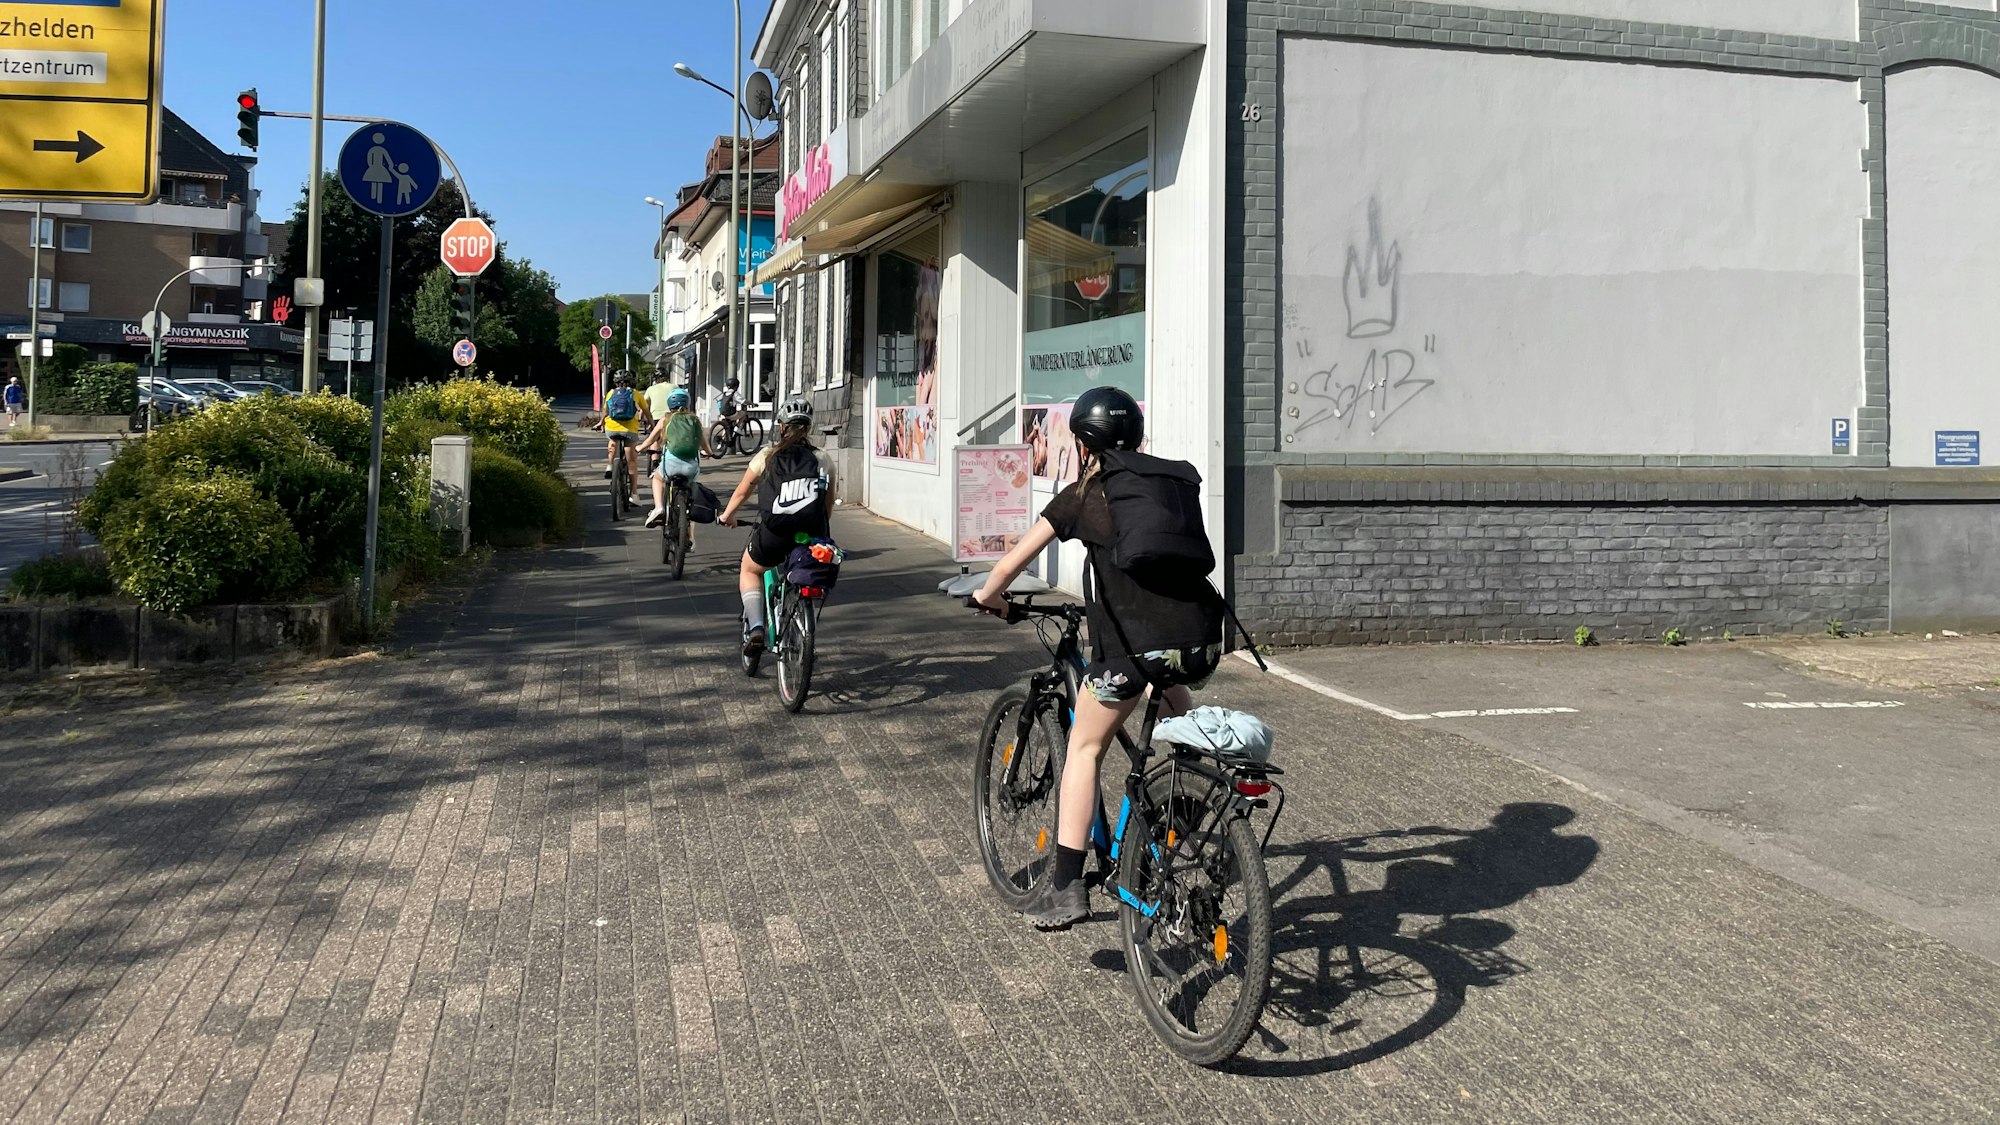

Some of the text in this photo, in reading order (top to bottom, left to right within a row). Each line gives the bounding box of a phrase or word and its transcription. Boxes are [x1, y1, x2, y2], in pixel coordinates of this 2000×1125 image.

[1241, 102, 1261, 121] 26
[446, 236, 489, 258] STOP
[122, 323, 250, 339] KRNGYMNASTIK
[1835, 420, 1847, 437] P
[779, 477, 819, 504] NIKE
